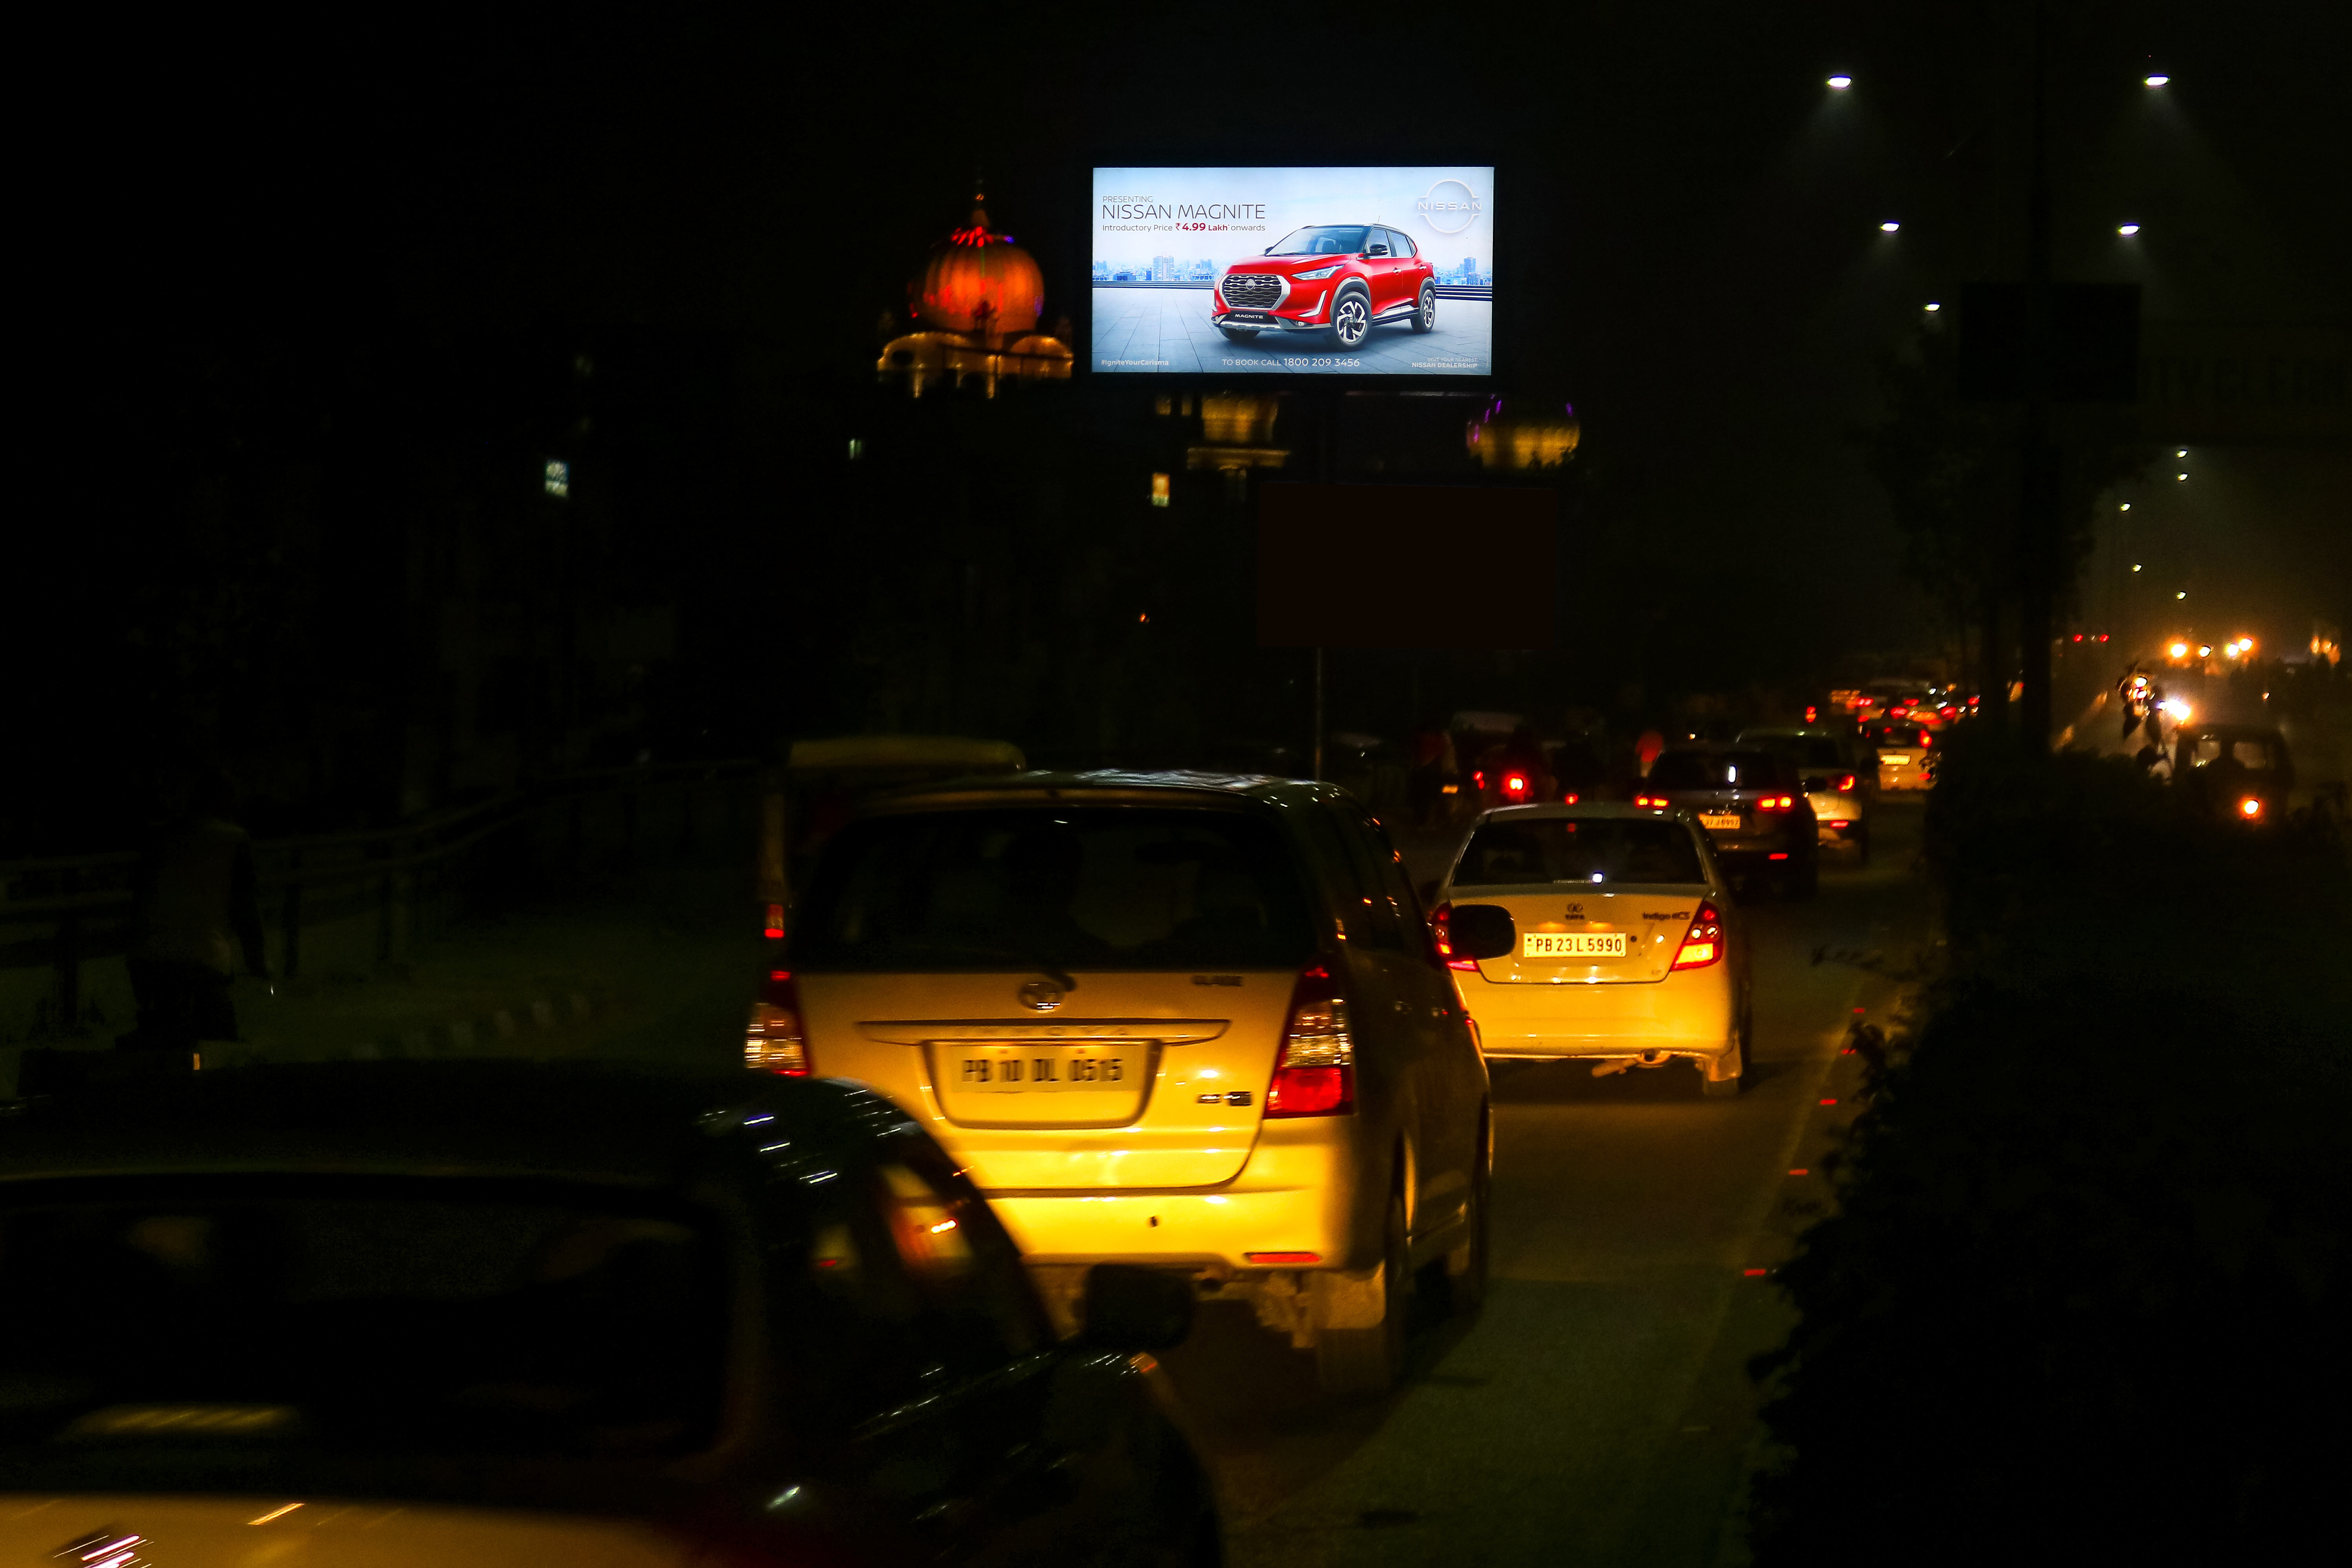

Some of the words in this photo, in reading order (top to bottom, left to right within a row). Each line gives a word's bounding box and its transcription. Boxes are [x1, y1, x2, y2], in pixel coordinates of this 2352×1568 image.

[1417, 201, 1482, 211] NISSAN
[1102, 204, 1172, 219] NISSAN
[1178, 204, 1266, 219] MAGNITE
[1102, 224, 1152, 232] Introductory
[1283, 358, 1309, 366] 1800
[1312, 358, 1331, 367] 209
[1334, 358, 1360, 367] 3456
[1536, 938, 1552, 952] PB
[1557, 938, 1572, 952] 23
[1577, 938, 1584, 952] L
[1588, 938, 1622, 952] 5990
